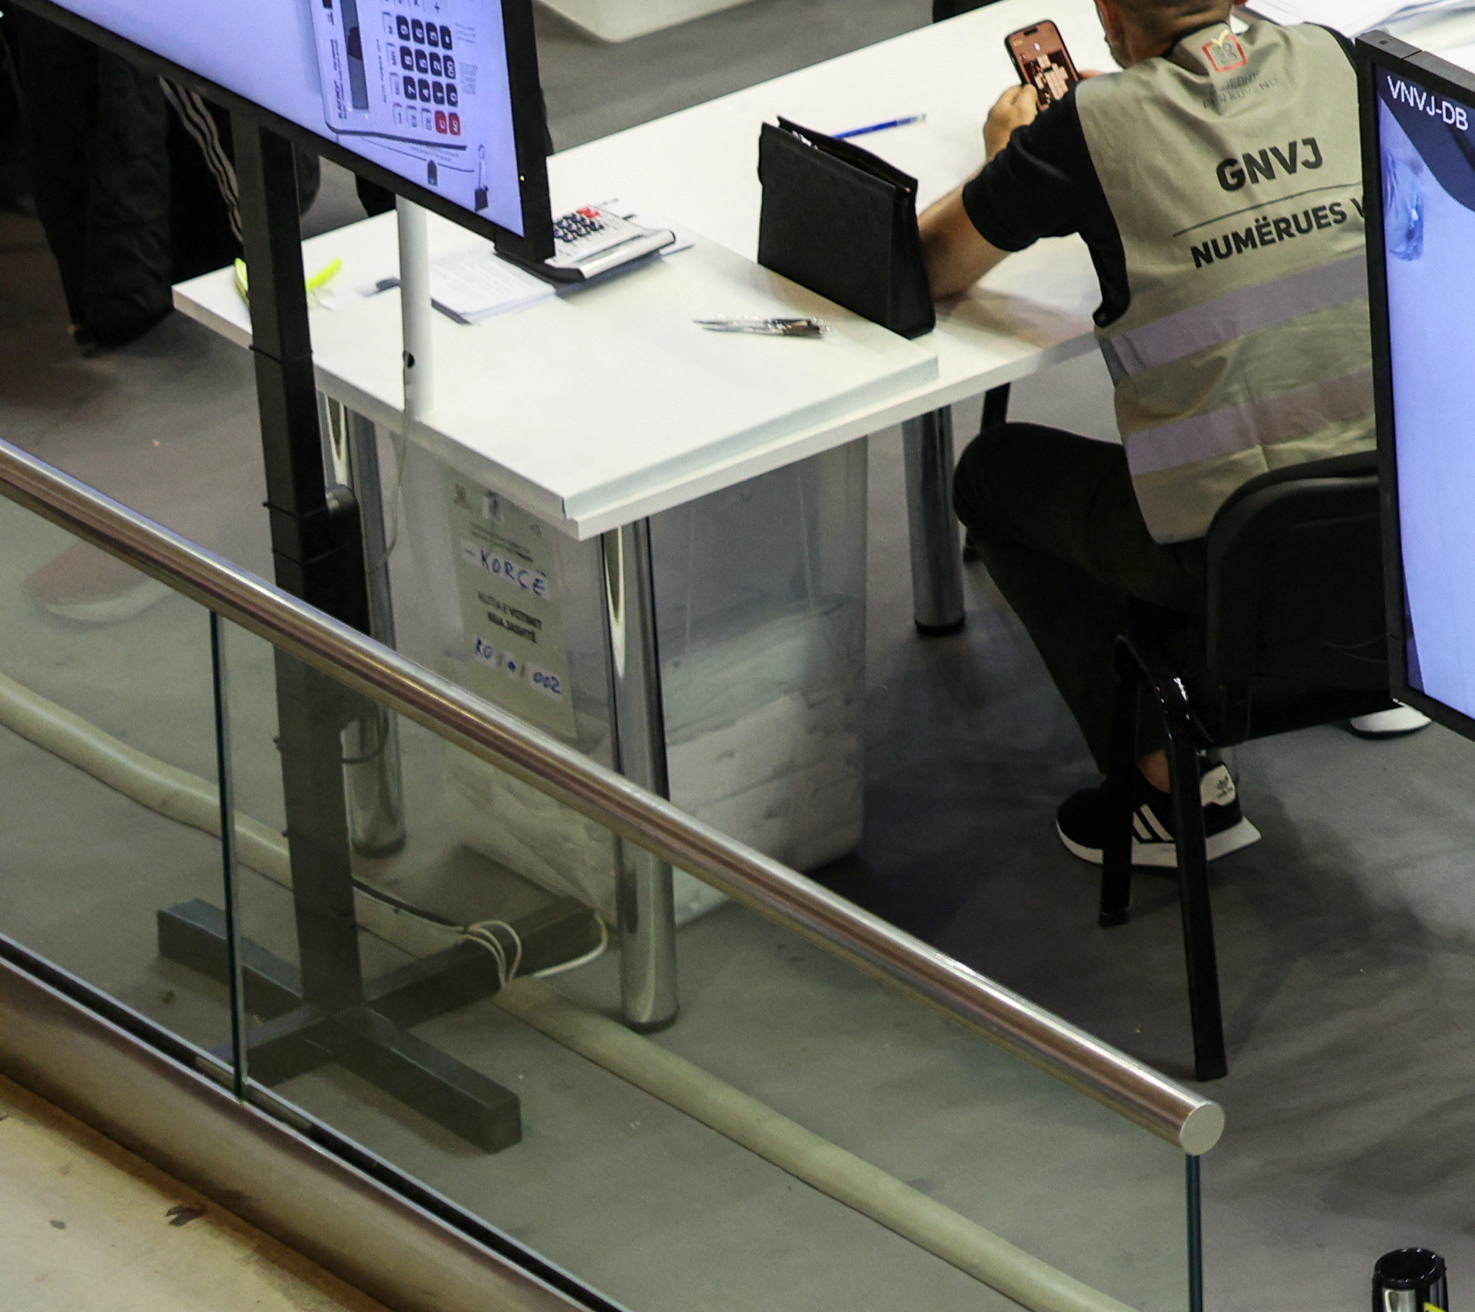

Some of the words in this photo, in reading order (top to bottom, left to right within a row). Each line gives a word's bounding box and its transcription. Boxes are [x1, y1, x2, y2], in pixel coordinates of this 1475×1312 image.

[1387, 75, 1469, 132] VNVJ-DB
[1215, 137, 1324, 193] GNVJ
[1189, 201, 1347, 270] NUMËRUES
